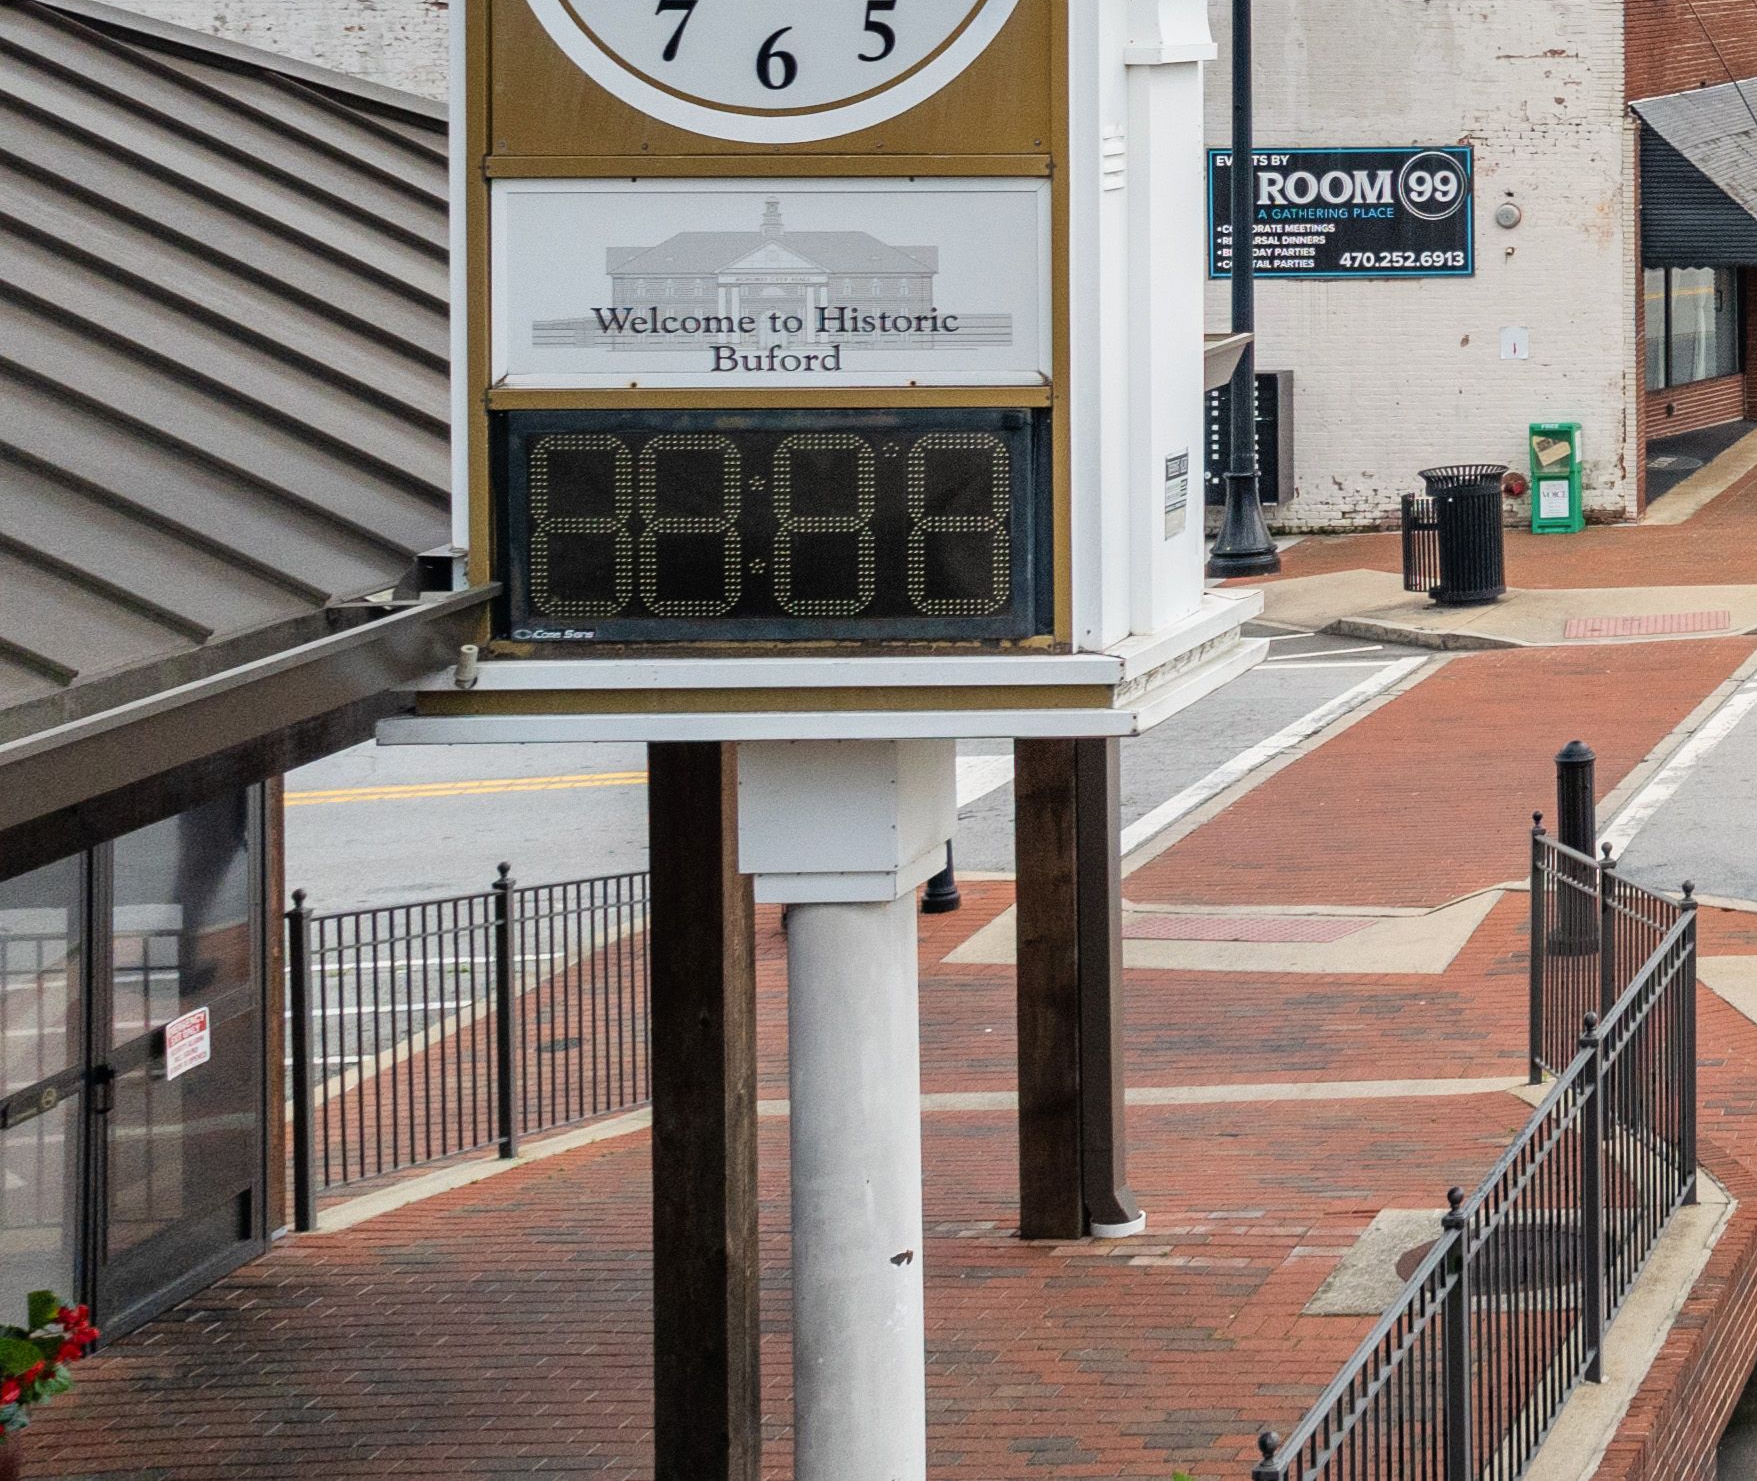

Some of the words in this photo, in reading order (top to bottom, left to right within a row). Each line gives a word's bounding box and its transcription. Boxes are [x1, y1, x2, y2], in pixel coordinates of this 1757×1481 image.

[756, 26, 797, 90] 6
[1216, 155, 1268, 166] EVTS
[1271, 155, 1289, 166] BY
[1256, 170, 1394, 205] ROOM
[1408, 170, 1458, 203] 99
[1258, 208, 1268, 219] A
[1272, 207, 1348, 219] GATHERING
[1353, 207, 1394, 218] PLACE
[1285, 223, 1336, 233] MEETINGS
[1282, 235, 1326, 245] DINNERS
[1275, 247, 1315, 257] PARTIES
[1274, 259, 1315, 268] PARTIES
[1339, 251, 1465, 268] 470.252.6913
[590, 306, 755, 334] Welcome
[769, 311, 803, 334] to
[814, 306, 960, 334] Historic
[709, 344, 842, 373] Buford
